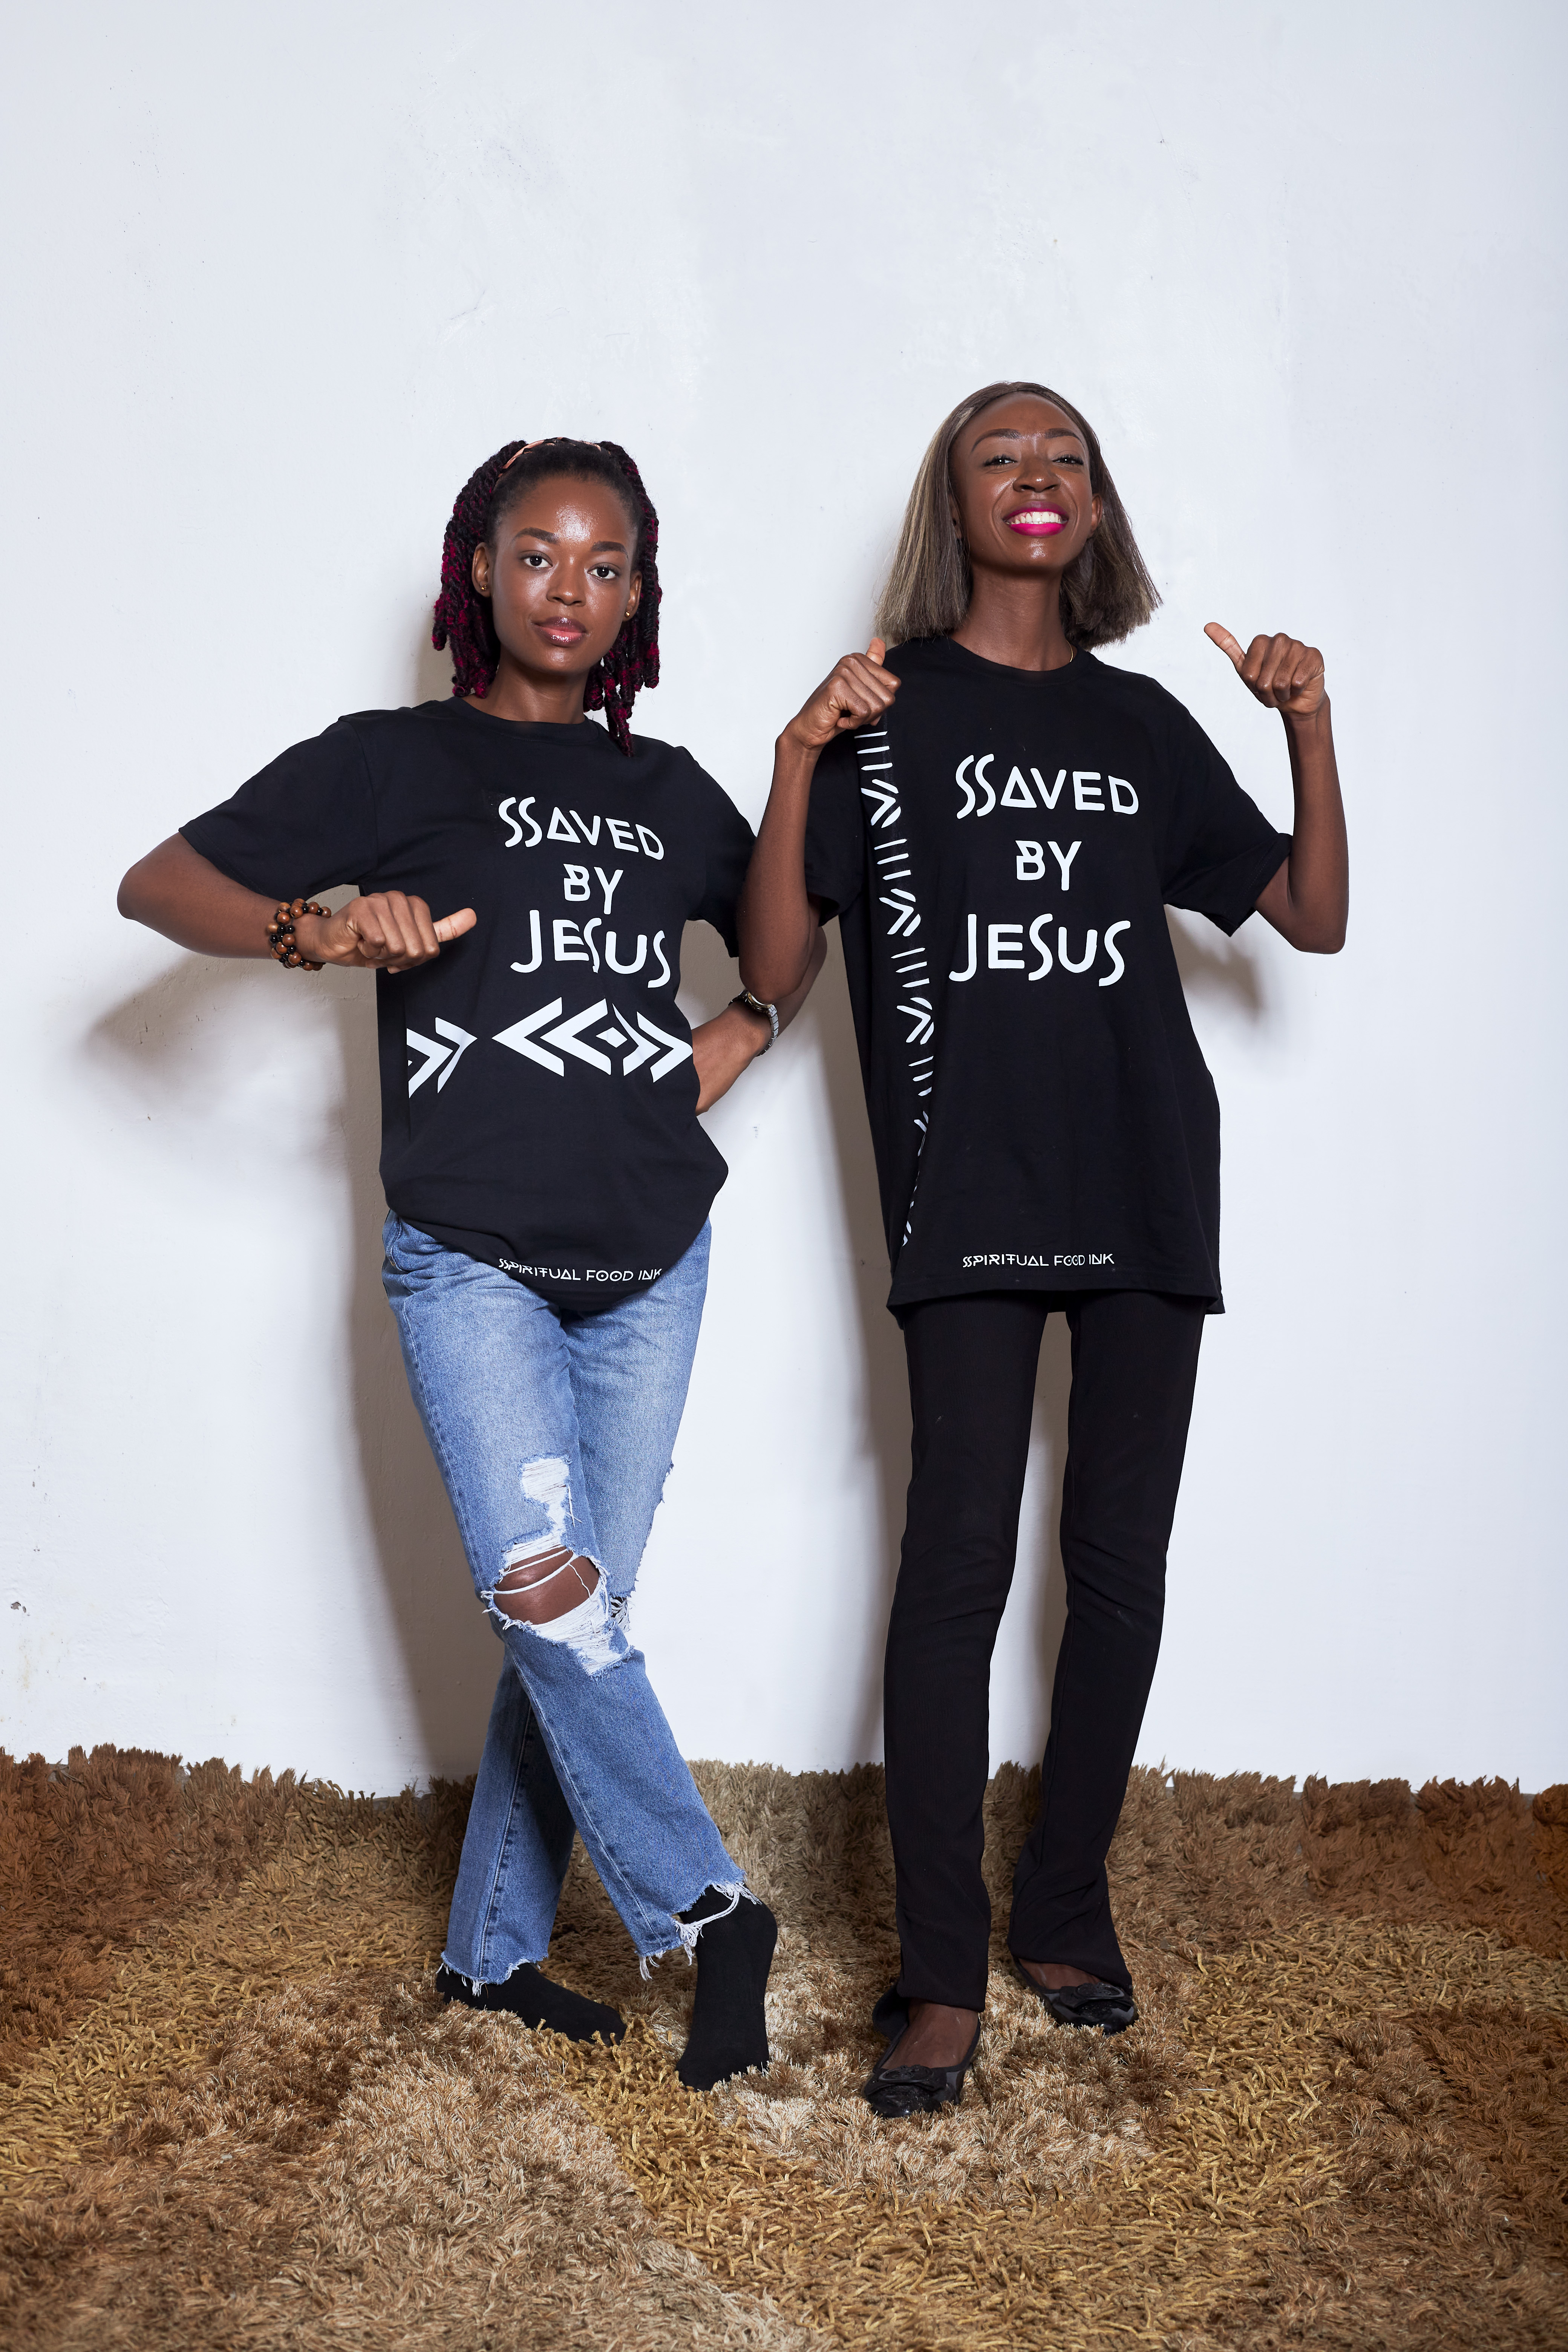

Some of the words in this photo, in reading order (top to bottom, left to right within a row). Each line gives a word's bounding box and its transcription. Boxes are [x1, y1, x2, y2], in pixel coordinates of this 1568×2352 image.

[564, 864, 624, 914] BY
[1015, 841, 1082, 891] BY
[510, 910, 671, 988] JESUS
[949, 914, 1131, 986] JESUS
[586, 1270, 634, 1281] FOOD
[638, 1268, 662, 1280] INK
[1054, 1255, 1085, 1266] FOOD
[1089, 1254, 1115, 1264] INK
